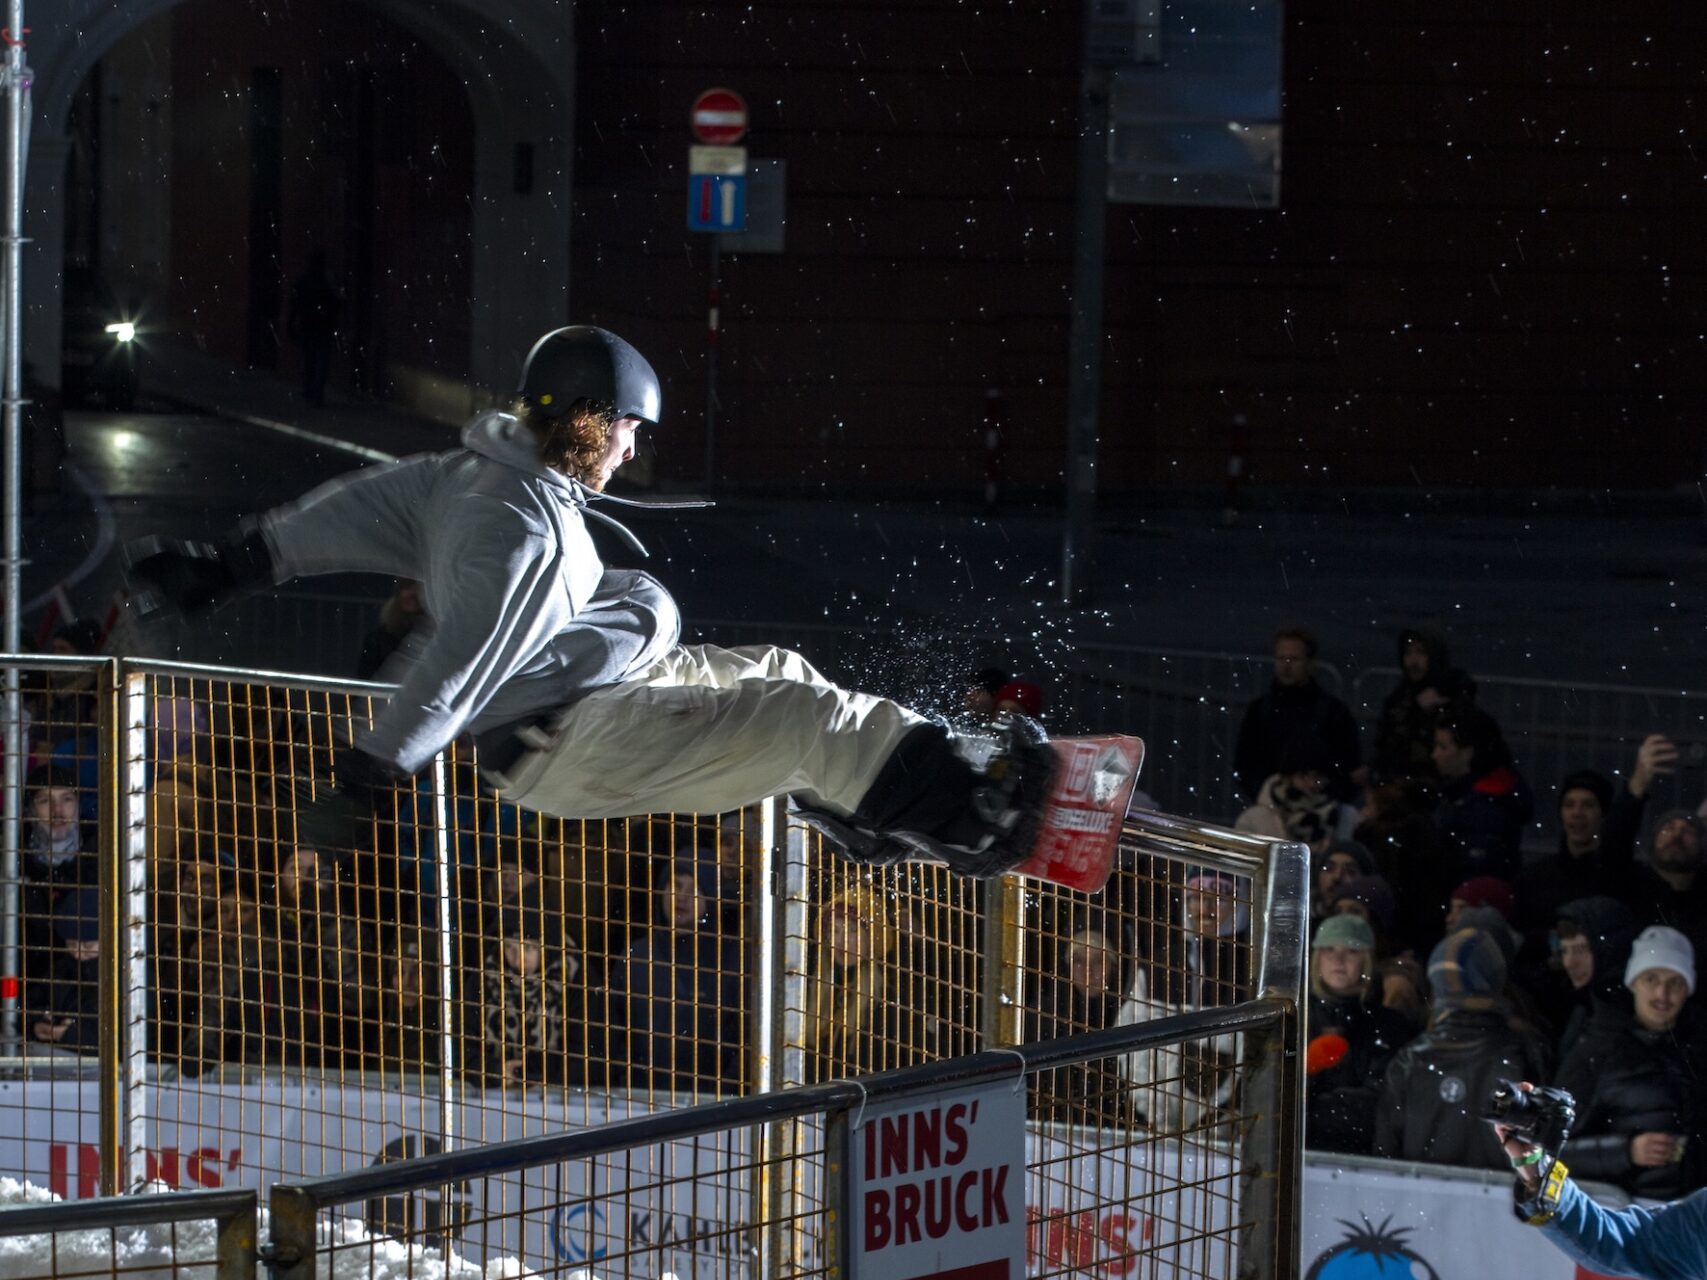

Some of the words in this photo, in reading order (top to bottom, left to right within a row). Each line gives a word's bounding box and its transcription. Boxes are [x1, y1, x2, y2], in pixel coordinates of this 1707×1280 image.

[864, 1100, 979, 1182] INNS'
[864, 1164, 1010, 1253] BRUCK
[1026, 1205, 1155, 1276] NS'
